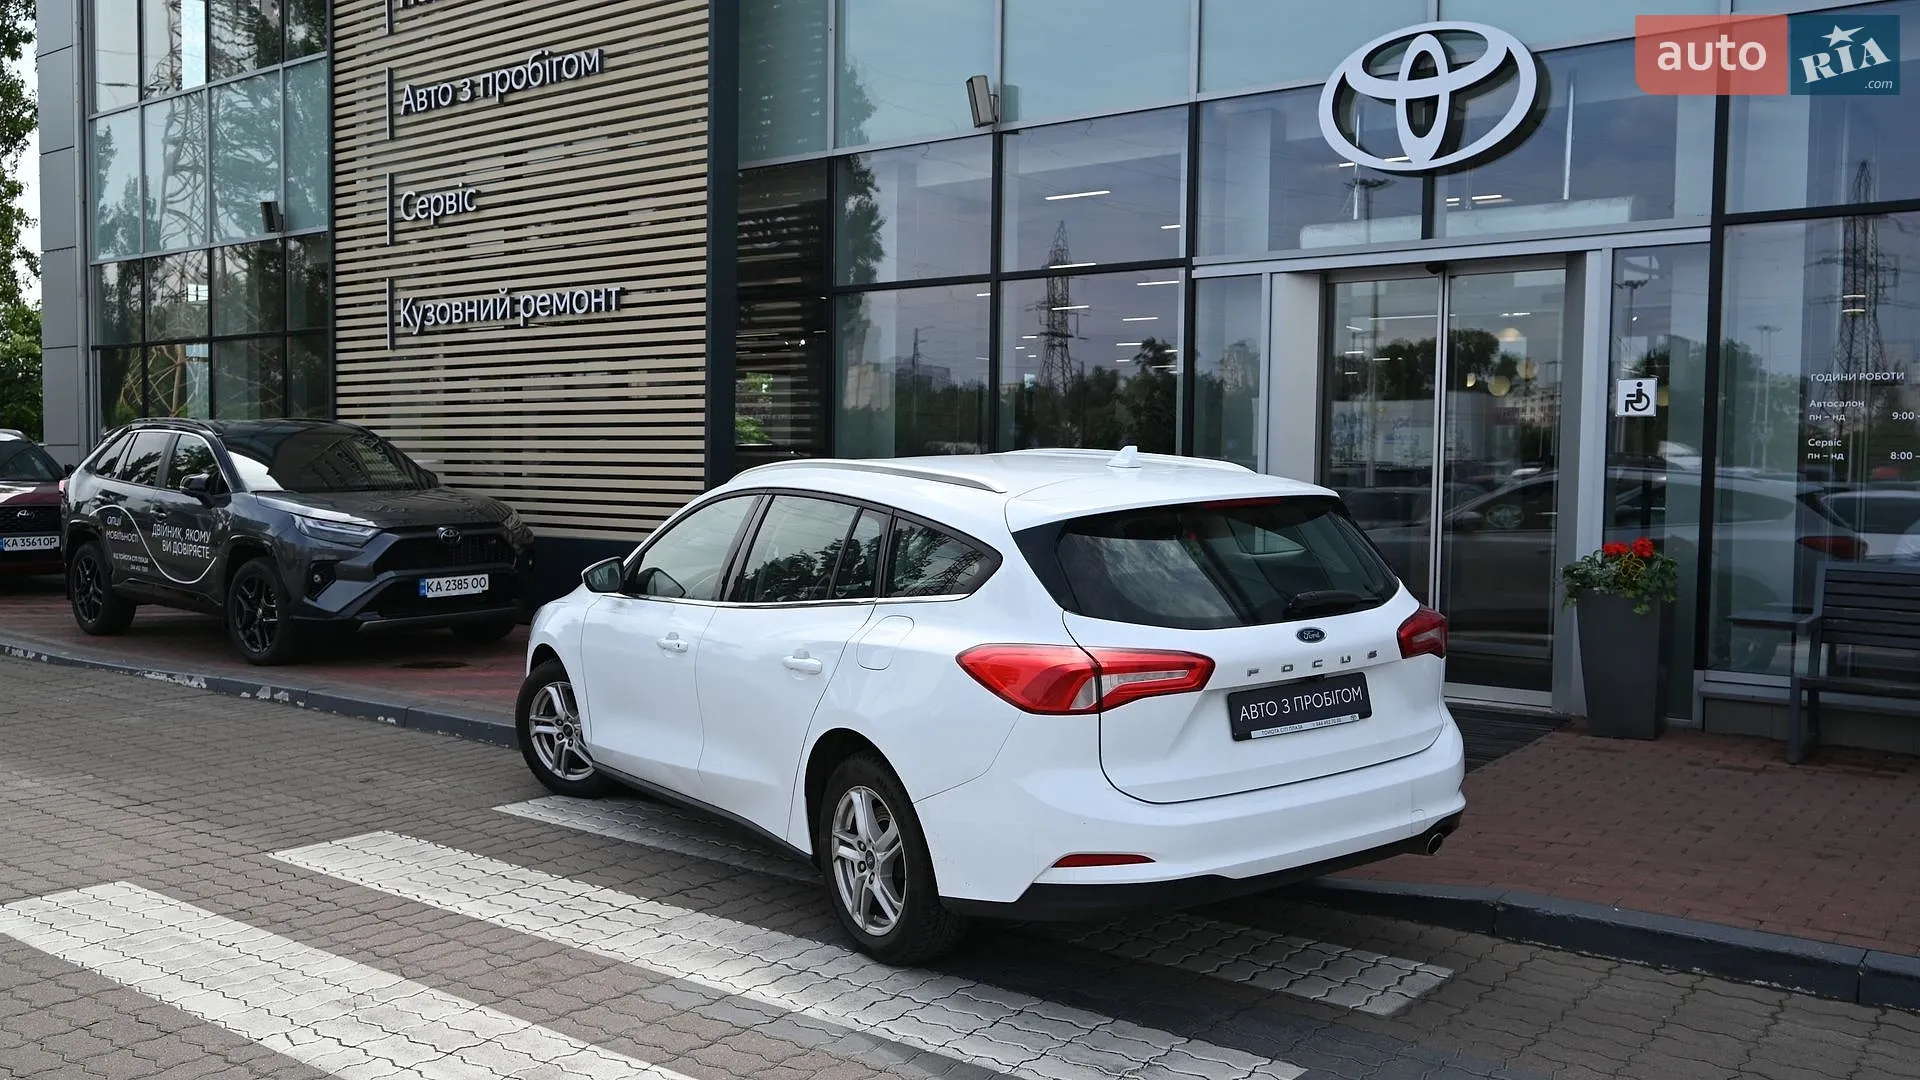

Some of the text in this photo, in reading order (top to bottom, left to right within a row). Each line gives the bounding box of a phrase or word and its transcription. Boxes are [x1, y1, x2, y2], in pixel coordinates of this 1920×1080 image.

[401, 49, 602, 115] Авто з пробігом
[401, 182, 478, 225] Сервіс
[401, 286, 623, 335] Кузовний ремонт
[1810, 372, 1905, 382] ГОДИНИ РОБОТИ
[1809, 399, 1865, 408] Автосалон
[1891, 411, 1915, 420] 9:00
[1807, 438, 1842, 448] Сервіс
[1890, 451, 1913, 460] 8:00
[3, 538, 18, 548] KA
[20, 537, 41, 547] 3561
[185, 528, 212, 544] ЯКОМУ
[427, 576, 487, 593] KA 2385 OO
[1247, 650, 1377, 677] FOCUS
[1240, 686, 1363, 722] АВТО З ПРОБІГОМ
